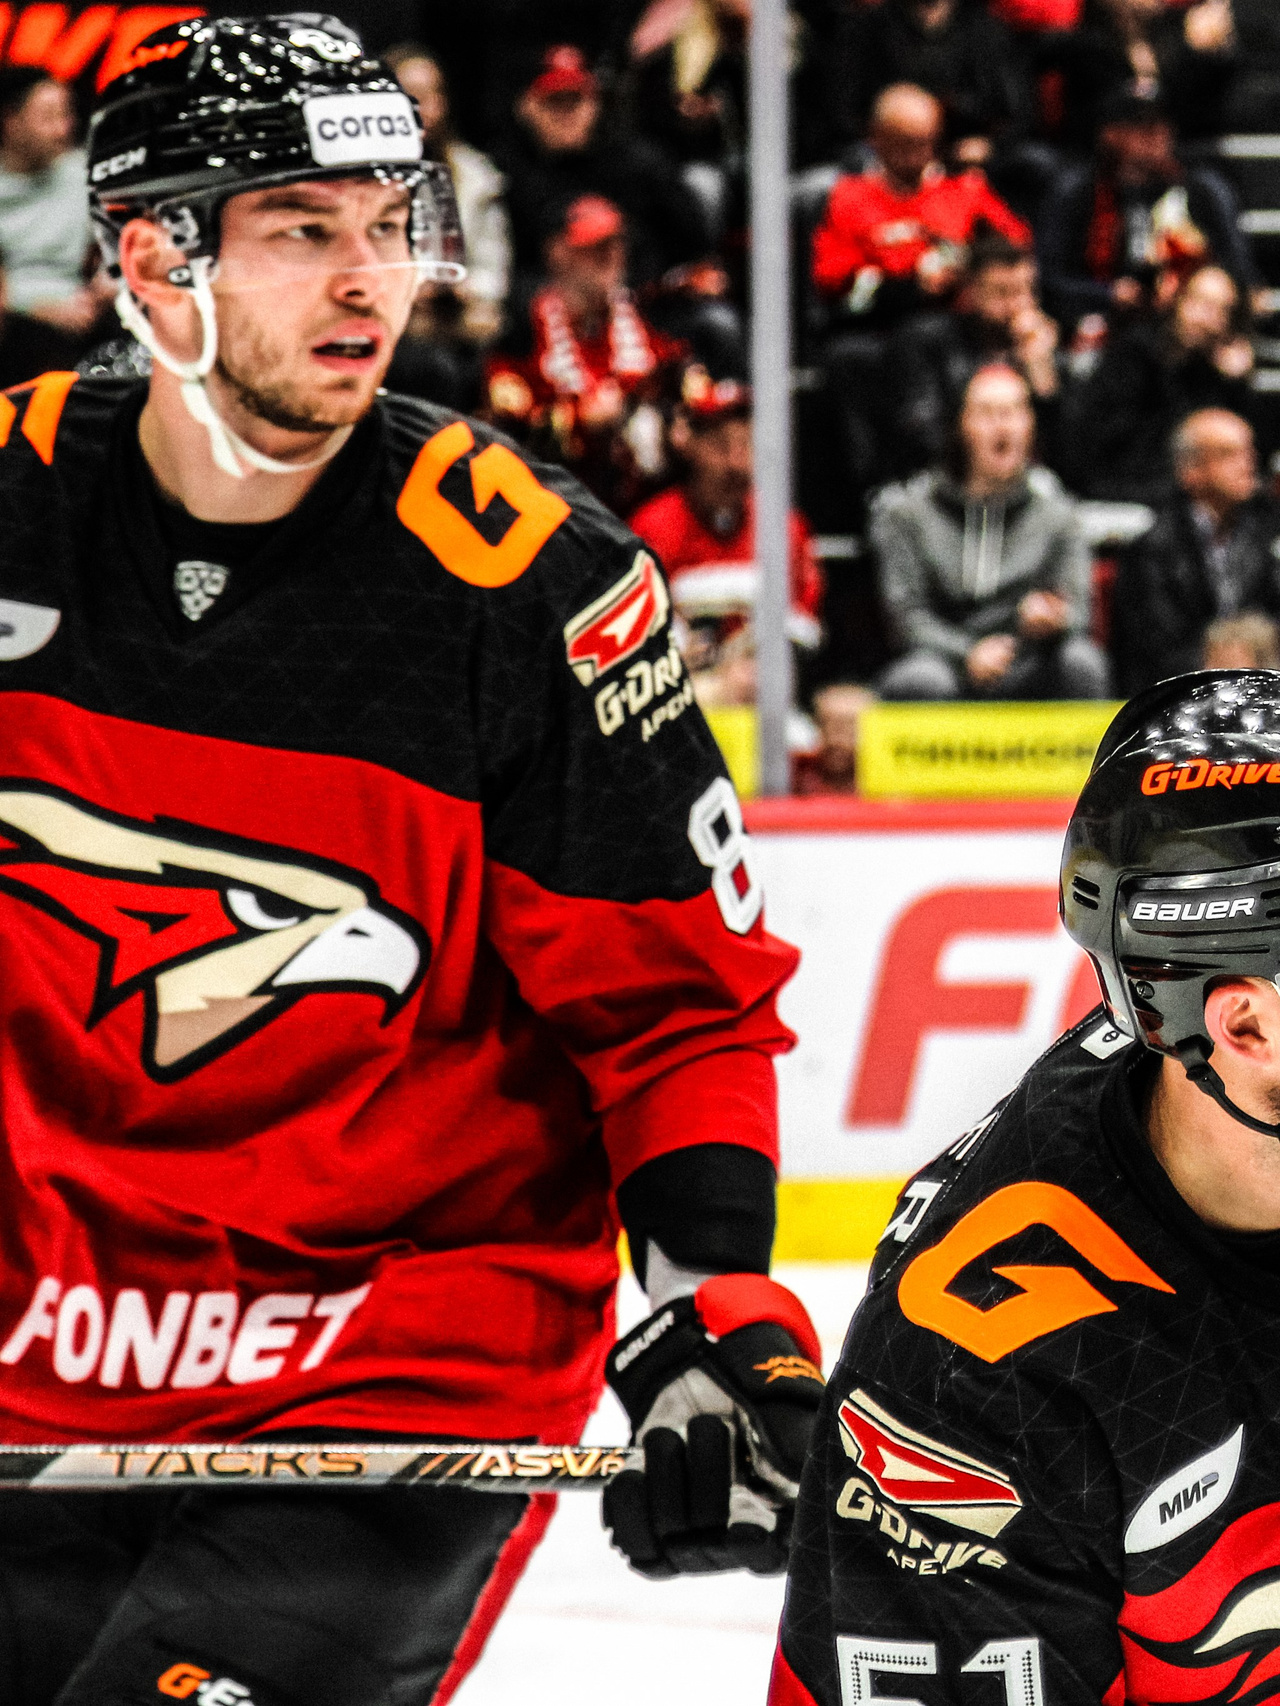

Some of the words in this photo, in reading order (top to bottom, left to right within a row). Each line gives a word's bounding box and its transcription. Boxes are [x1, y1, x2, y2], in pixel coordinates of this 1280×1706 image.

[897, 1181, 1177, 1364] G
[0, 1275, 374, 1390] FONBET
[98, 1446, 367, 1480] TACKS
[1158, 1471, 1220, 1526] МИР
